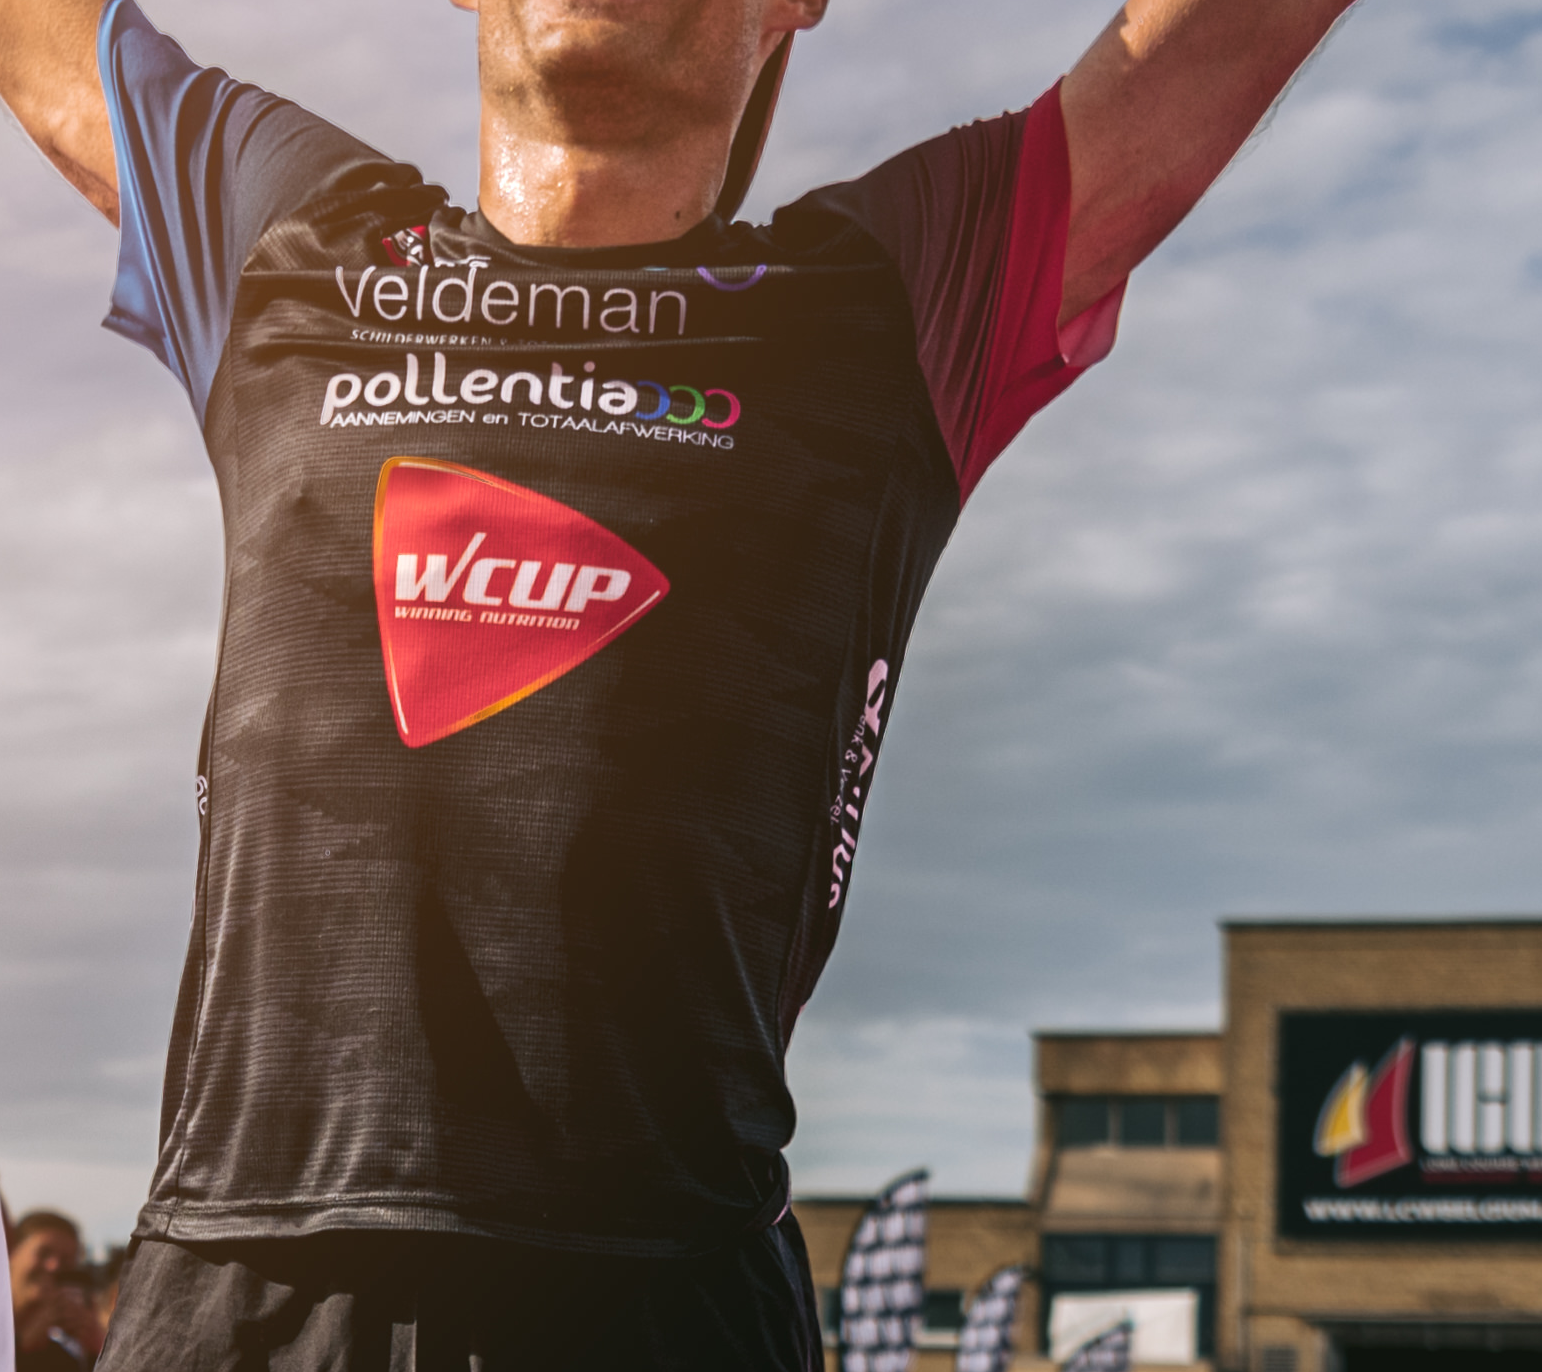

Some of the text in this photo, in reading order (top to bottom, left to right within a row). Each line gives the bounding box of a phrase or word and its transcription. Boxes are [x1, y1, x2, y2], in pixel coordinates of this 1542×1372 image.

[335, 264, 688, 335] Veldeman
[320, 351, 638, 426] pollentia
[330, 409, 734, 450] AANNEMINGEN en TOTAALAFWERKING
[394, 605, 580, 630] WINNING NUTRITION
